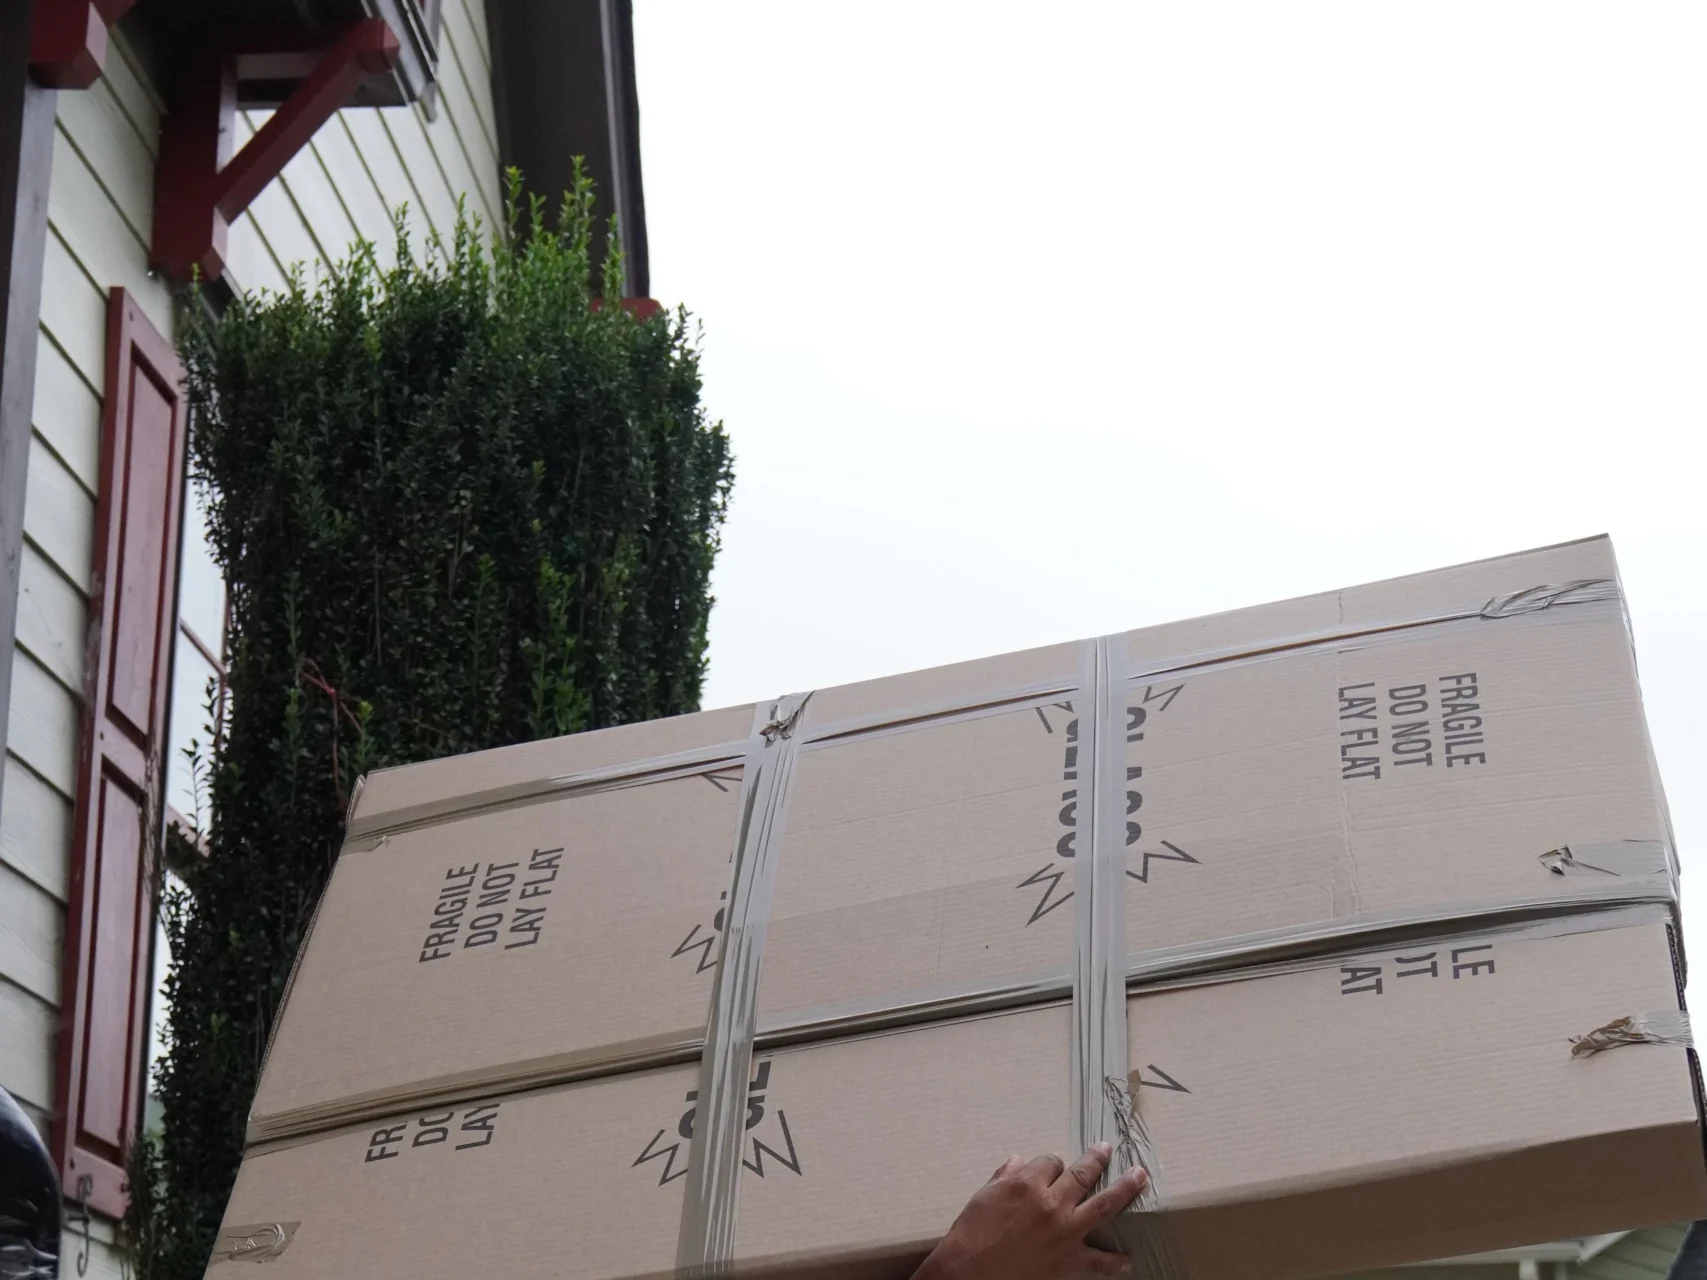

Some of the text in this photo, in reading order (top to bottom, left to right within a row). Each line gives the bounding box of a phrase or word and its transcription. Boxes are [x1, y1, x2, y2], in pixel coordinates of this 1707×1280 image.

[1338, 682, 1381, 779] LAY FLAT
[1388, 684, 1433, 766] DO NOT
[1438, 672, 1486, 768] FRAGILE
[418, 862, 480, 963] FRAGILE
[463, 862, 520, 948] DO NOT
[504, 847, 565, 950] LAY FLAT
[1340, 965, 1383, 995] AT
